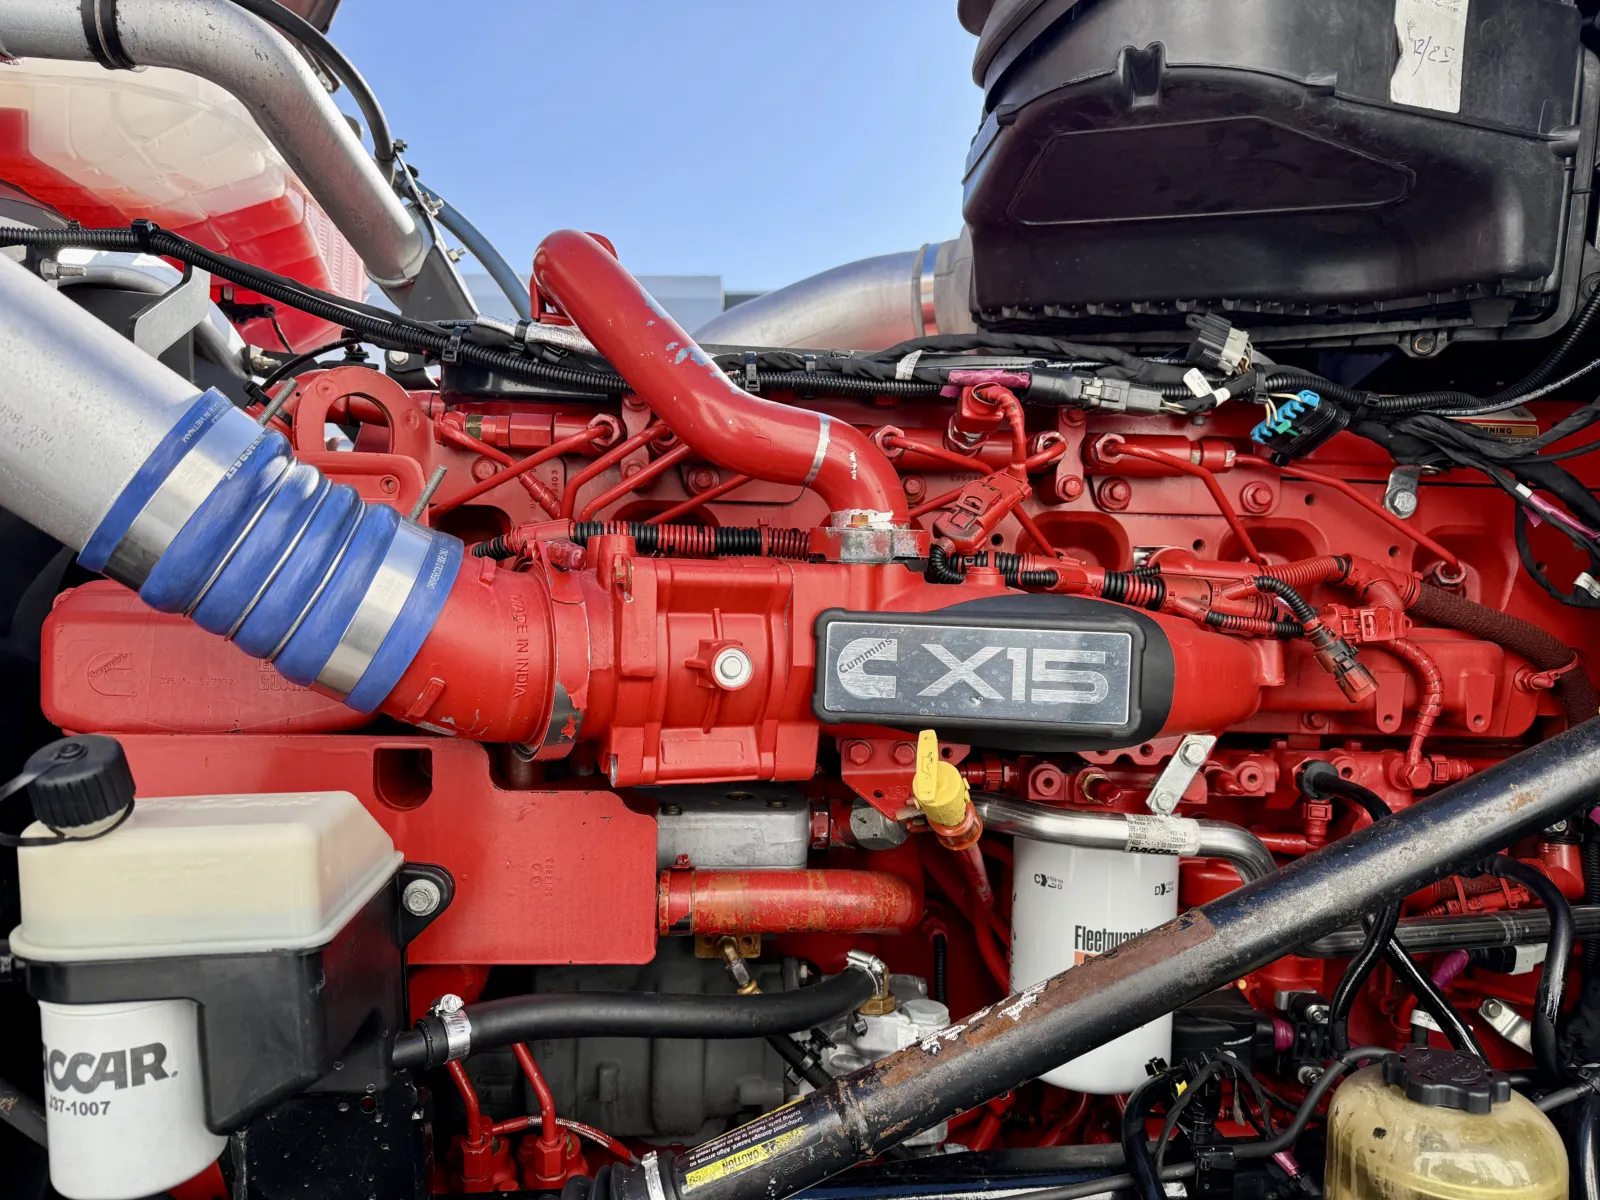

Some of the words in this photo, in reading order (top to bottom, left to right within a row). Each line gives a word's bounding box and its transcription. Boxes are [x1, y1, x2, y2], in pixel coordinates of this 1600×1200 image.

[182, 412, 207, 444] VIETNAM
[510, 594, 528, 634] MADE
[516, 639, 529, 654] IN
[839, 639, 893, 674] Cummins
[513, 658, 529, 699] INDIA
[916, 643, 1109, 705] X15
[42, 1041, 170, 1094] ACCAR
[747, 1124, 766, 1135] Failure
[750, 1128, 773, 1141] damage
[710, 1141, 726, 1151] could
[715, 1146, 731, 1156] Align
[731, 1138, 751, 1150] hazard.
[694, 1148, 711, 1158] result
[696, 1152, 716, 1163] arrows
[722, 1149, 760, 1171] CAUTION
